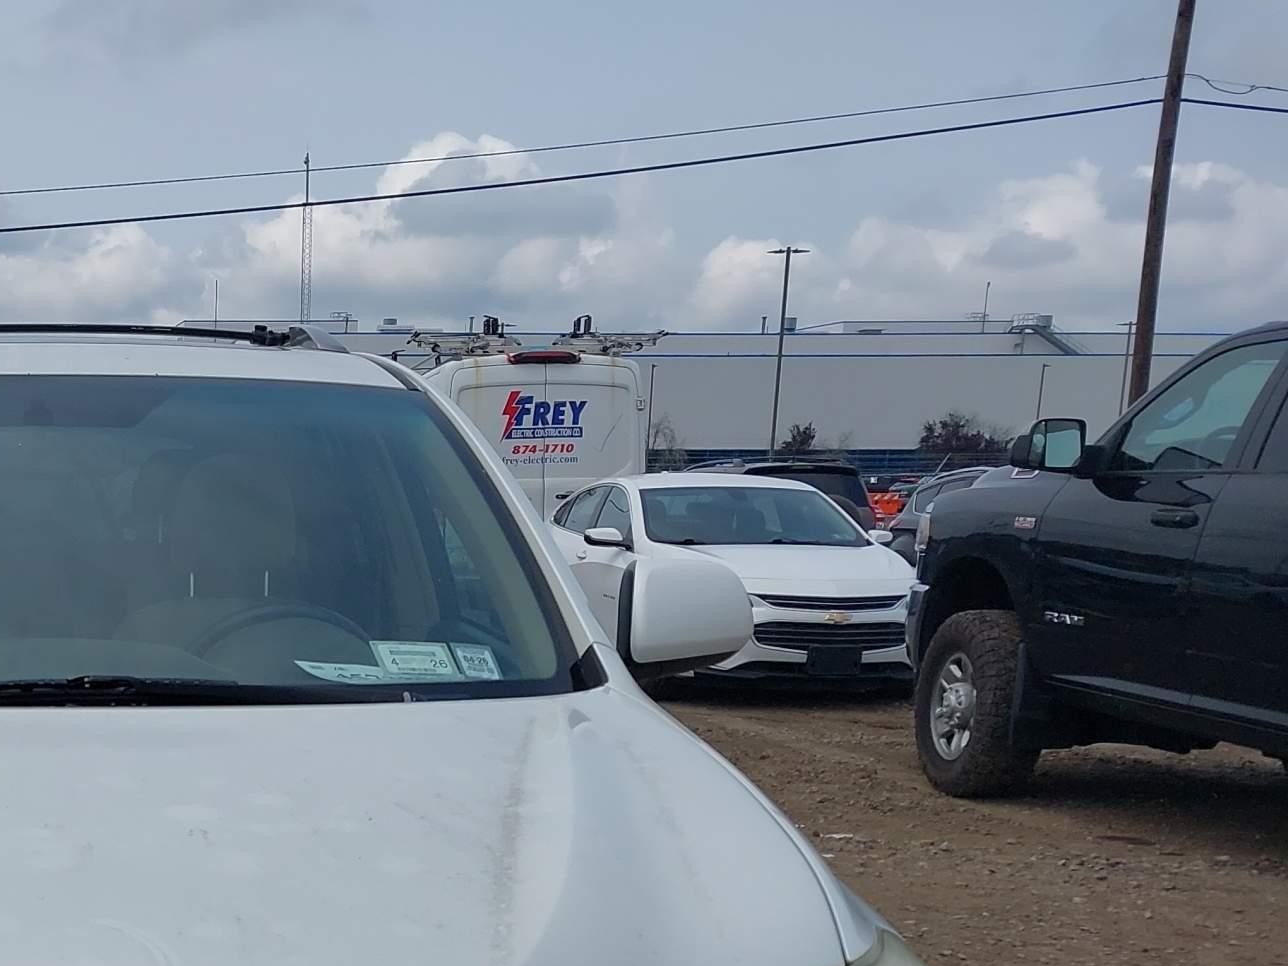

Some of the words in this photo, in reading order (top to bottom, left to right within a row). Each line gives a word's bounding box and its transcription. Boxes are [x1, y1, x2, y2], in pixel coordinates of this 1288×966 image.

[514, 395, 588, 427] FREY
[511, 430, 533, 438] ELECTRIC
[534, 429, 572, 438] CONSTRUCTION
[512, 443, 575, 454] 874-1710
